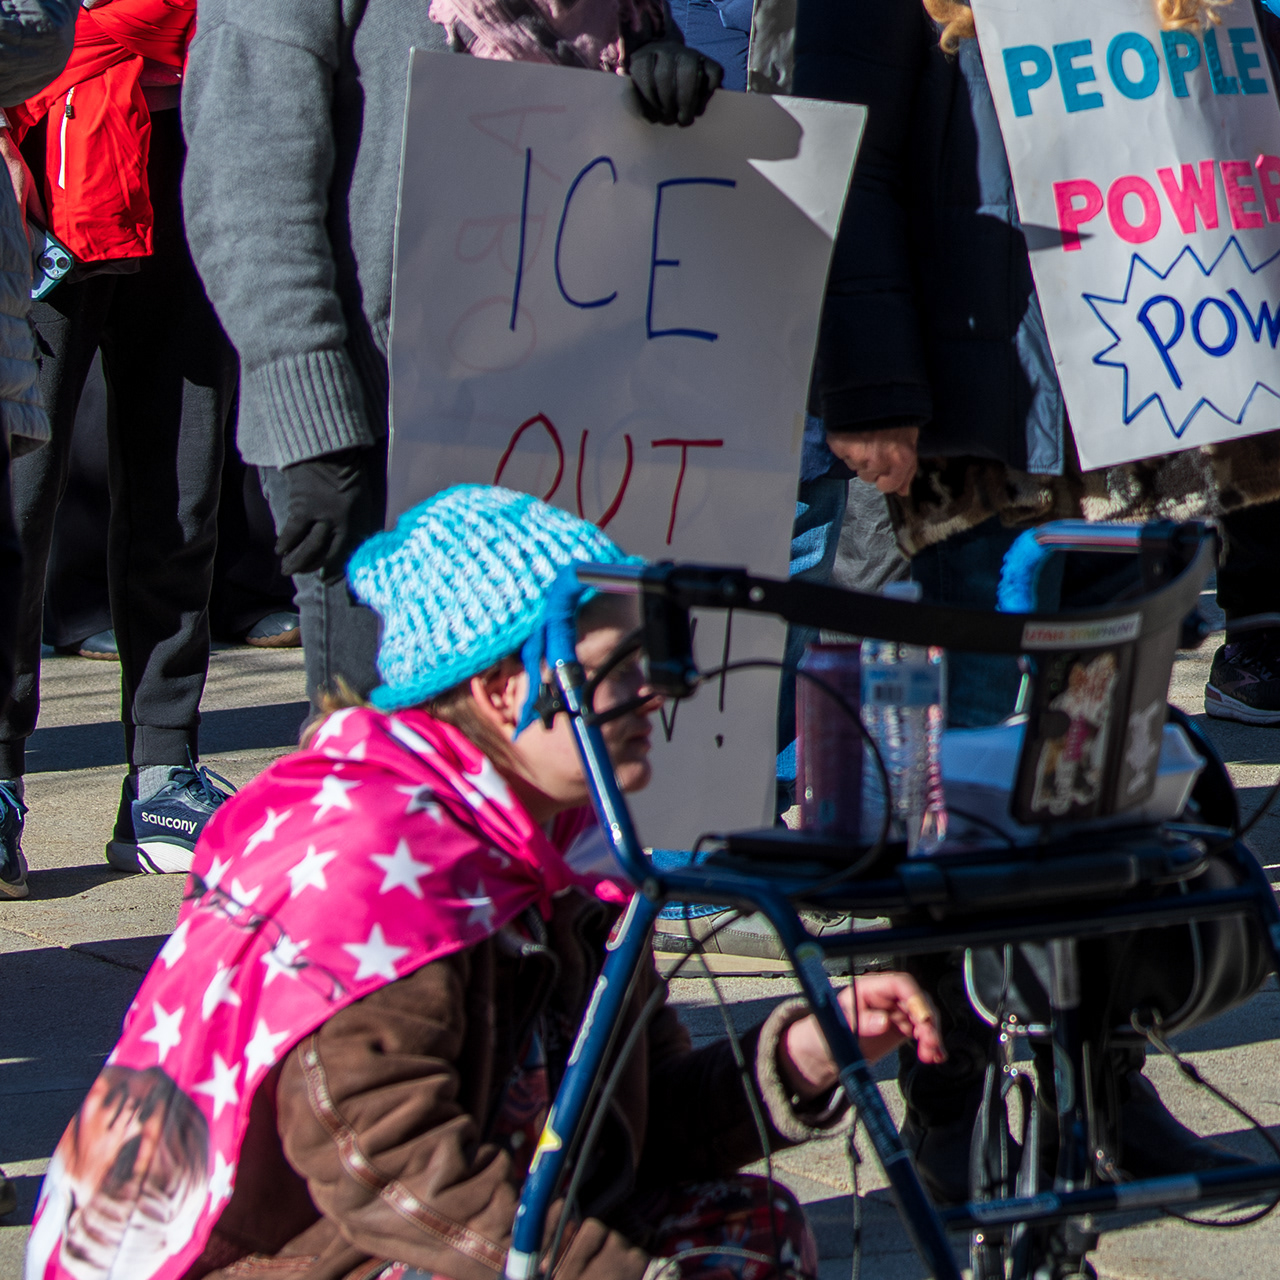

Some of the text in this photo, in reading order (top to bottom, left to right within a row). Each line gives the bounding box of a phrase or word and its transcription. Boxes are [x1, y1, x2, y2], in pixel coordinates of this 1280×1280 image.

[1002, 27, 1268, 117] PEOPLE
[510, 147, 736, 342] ICE
[493, 412, 723, 545] OUT
[141, 811, 198, 835] saucony
